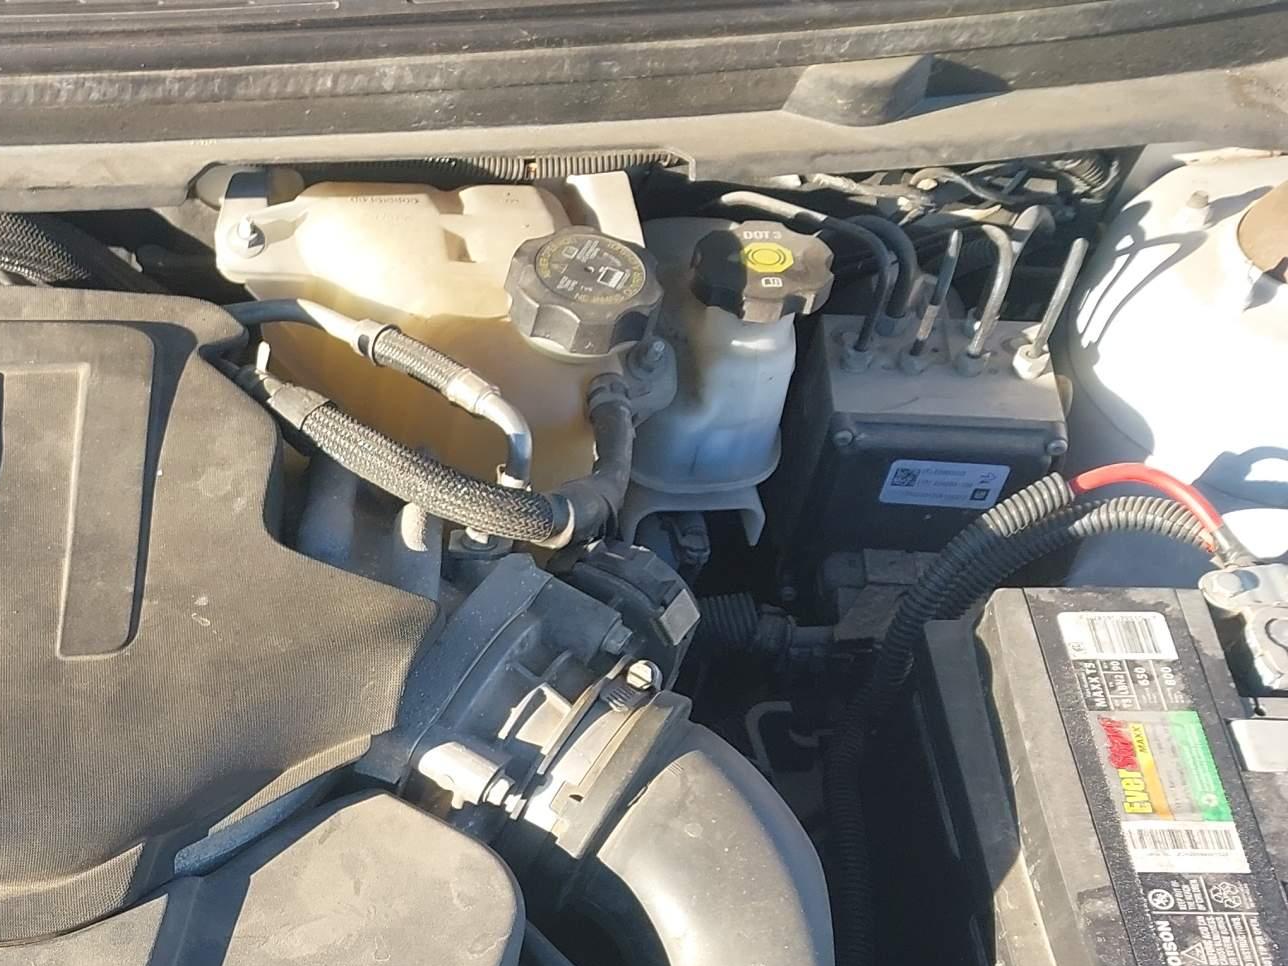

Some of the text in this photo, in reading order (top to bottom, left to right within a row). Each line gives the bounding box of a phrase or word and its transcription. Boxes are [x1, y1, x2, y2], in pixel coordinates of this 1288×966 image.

[743, 231, 782, 239] DOT 3
[1110, 662, 1121, 671] 90
[1161, 666, 1176, 685] 800
[1134, 667, 1150, 686] 650
[1088, 676, 1107, 707] MAXX
[1131, 725, 1147, 753] MAXX
